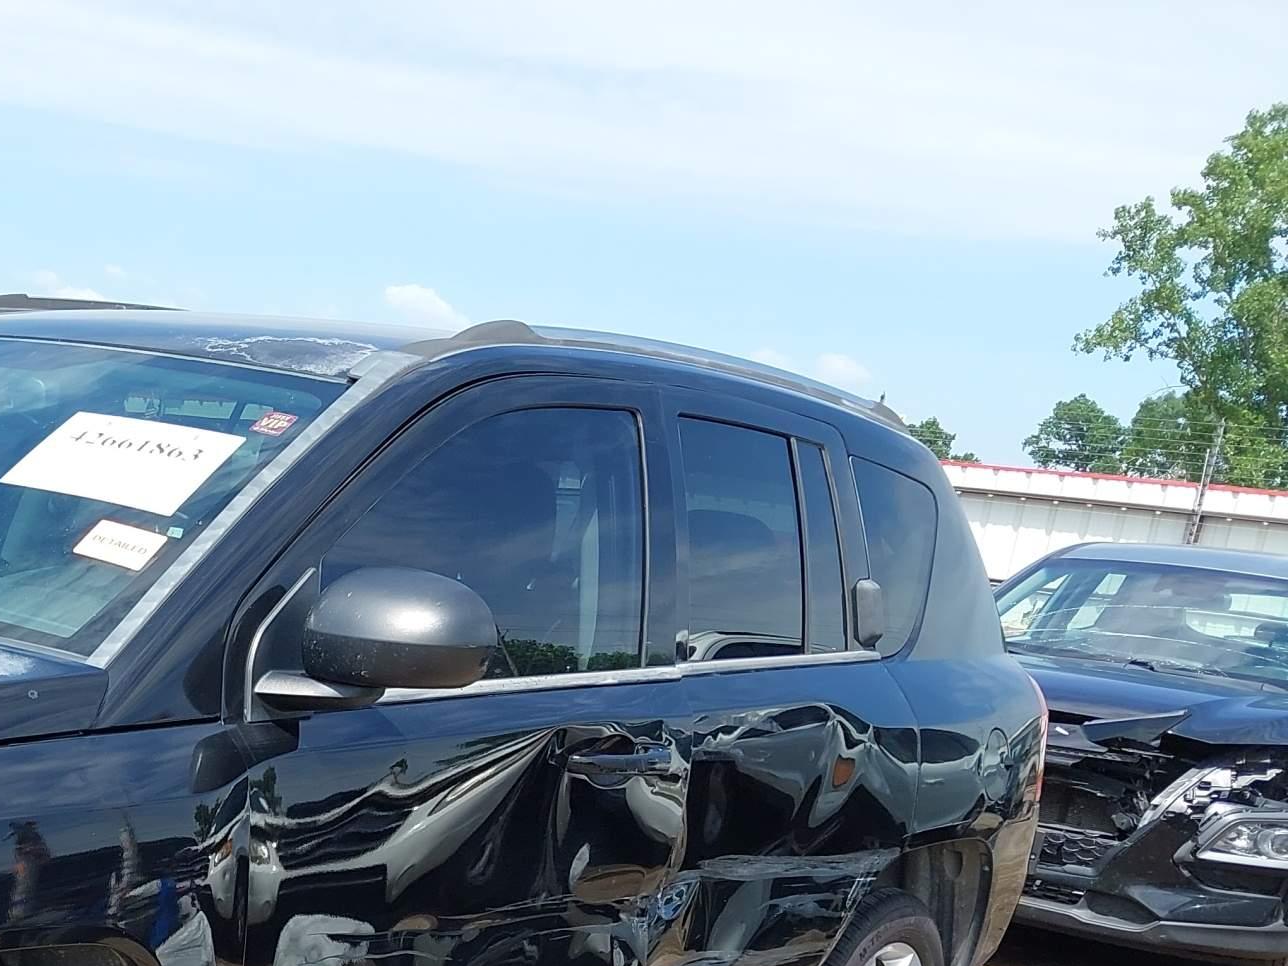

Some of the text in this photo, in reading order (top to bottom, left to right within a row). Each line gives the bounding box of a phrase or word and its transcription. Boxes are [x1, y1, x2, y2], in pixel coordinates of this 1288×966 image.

[260, 417, 289, 429] VIP
[70, 430, 204, 461] 42661863
[92, 534, 148, 555] DETAILED
